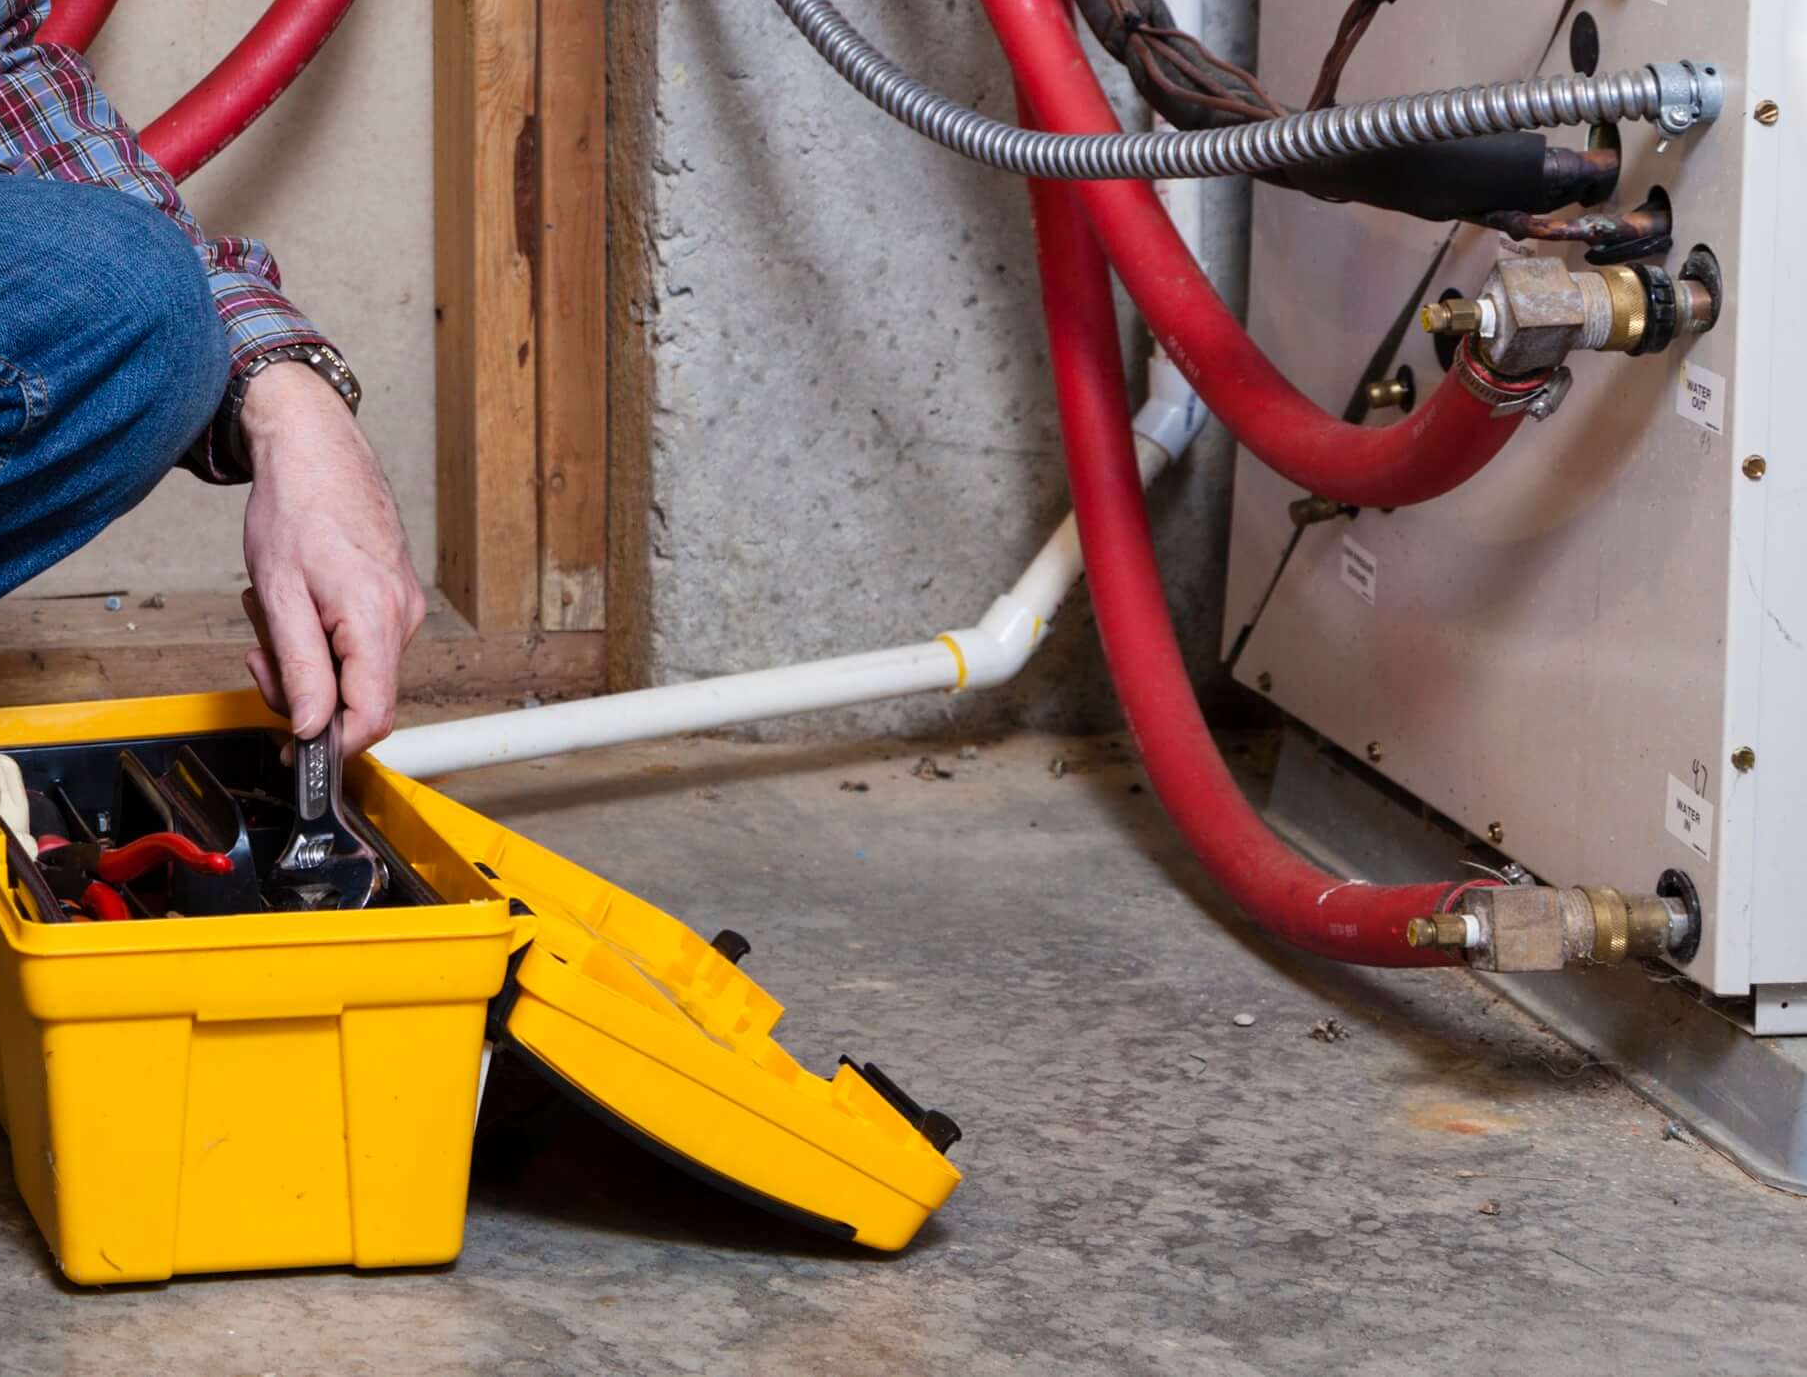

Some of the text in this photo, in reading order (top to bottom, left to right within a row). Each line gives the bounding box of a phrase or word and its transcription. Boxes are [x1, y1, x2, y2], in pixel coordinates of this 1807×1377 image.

[1686, 379, 1712, 401] WATER
[1691, 396, 1707, 412] OUT
[1676, 798, 1701, 825] WATER
[1683, 818, 1692, 832] IN
